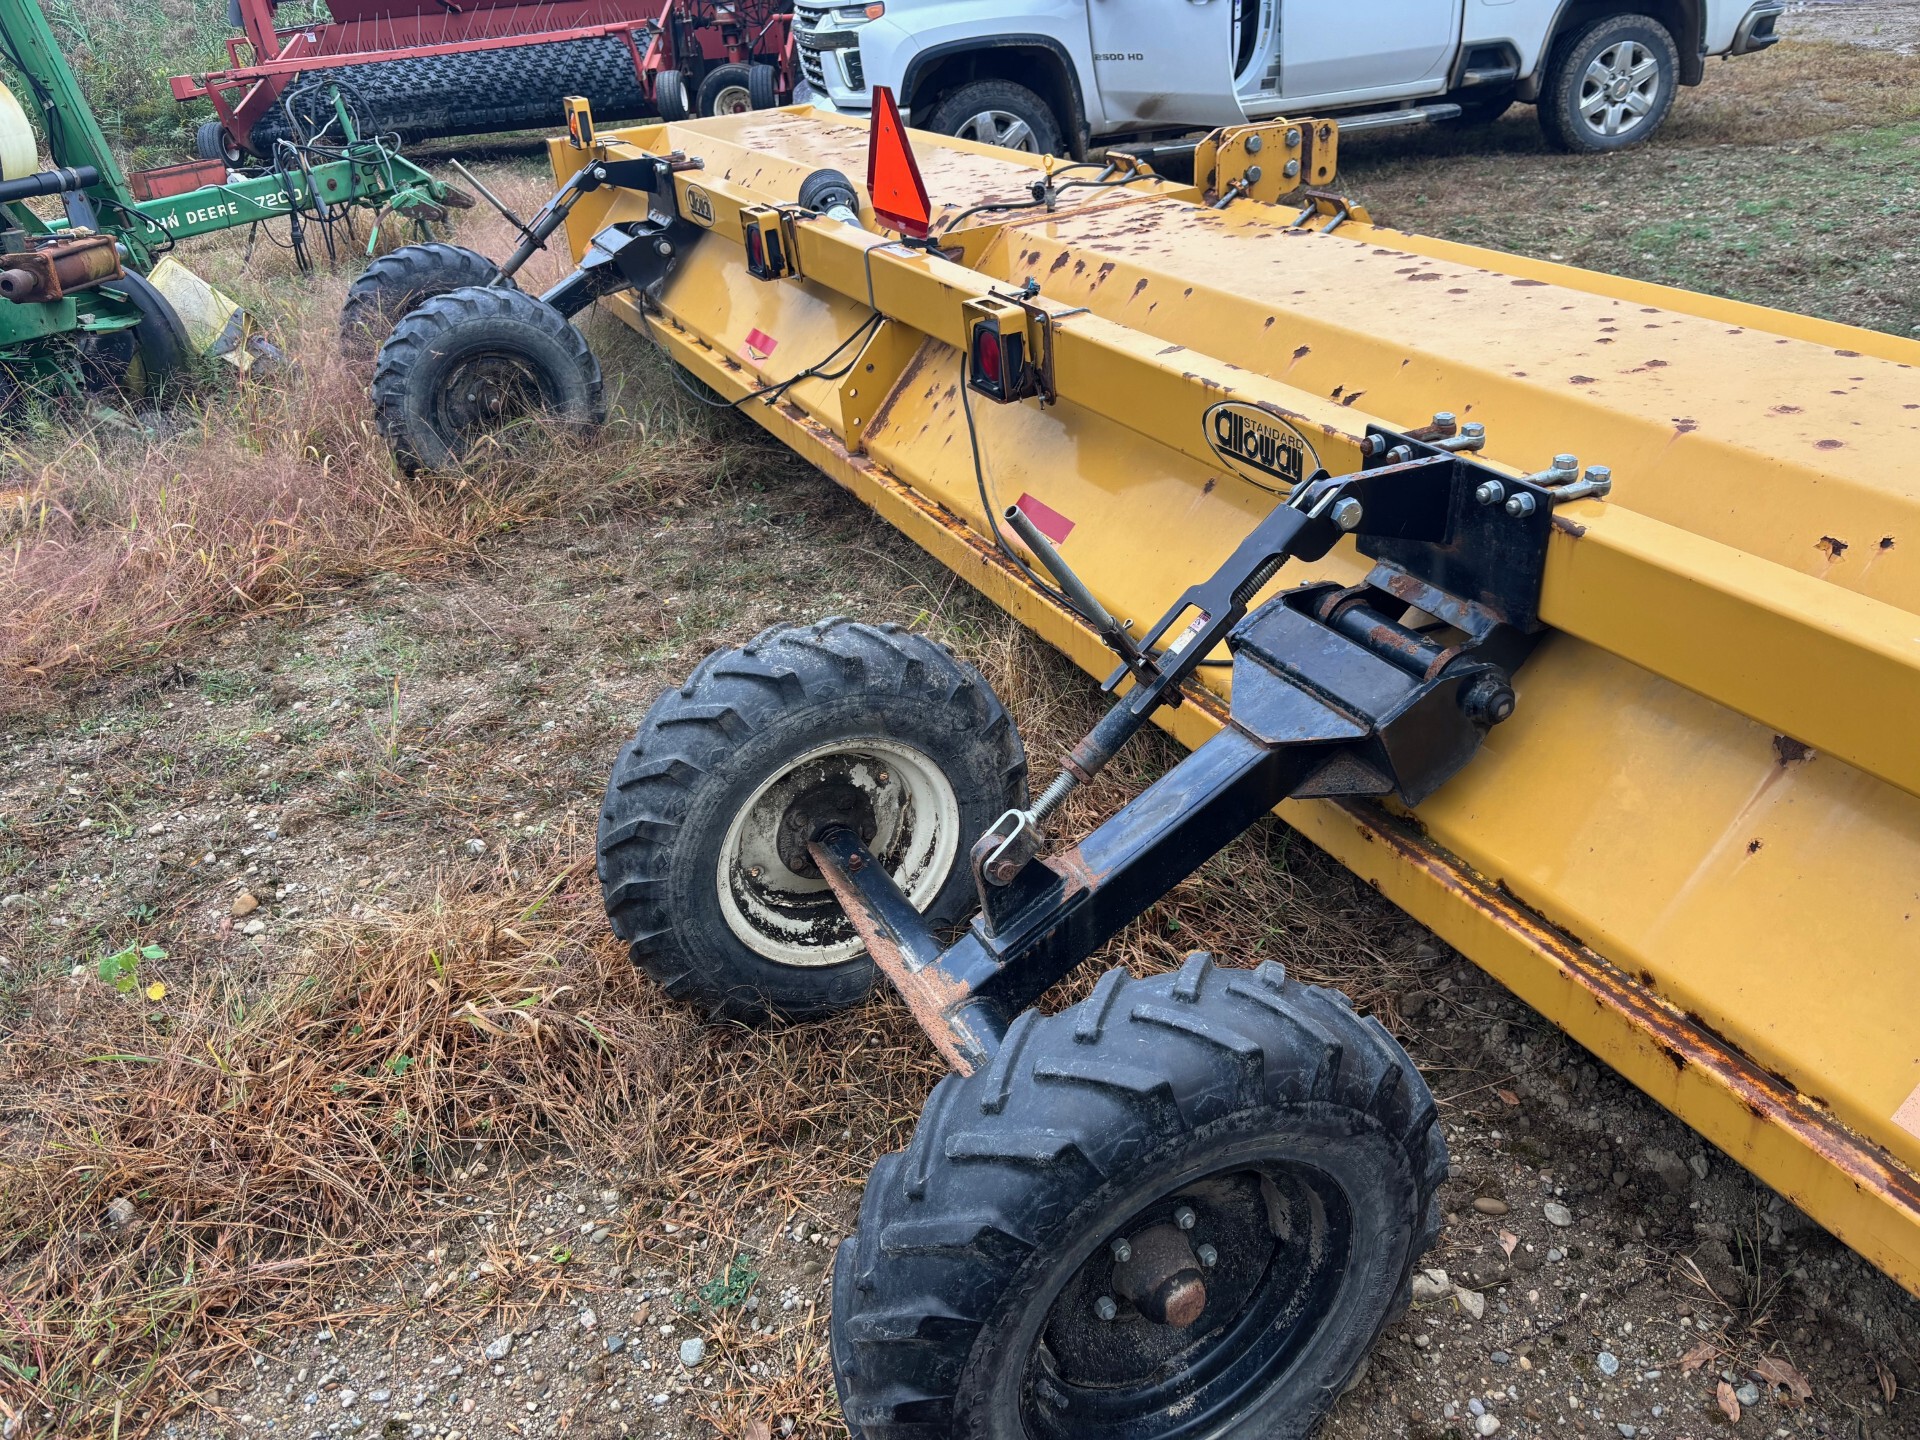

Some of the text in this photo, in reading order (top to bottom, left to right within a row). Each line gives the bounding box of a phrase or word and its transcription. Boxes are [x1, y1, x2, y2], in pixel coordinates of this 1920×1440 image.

[1094, 53, 1144, 61] 2500 HD
[146, 215, 180, 234] OHN
[185, 201, 239, 225] DEERE
[1243, 417, 1304, 450] STANDARD
